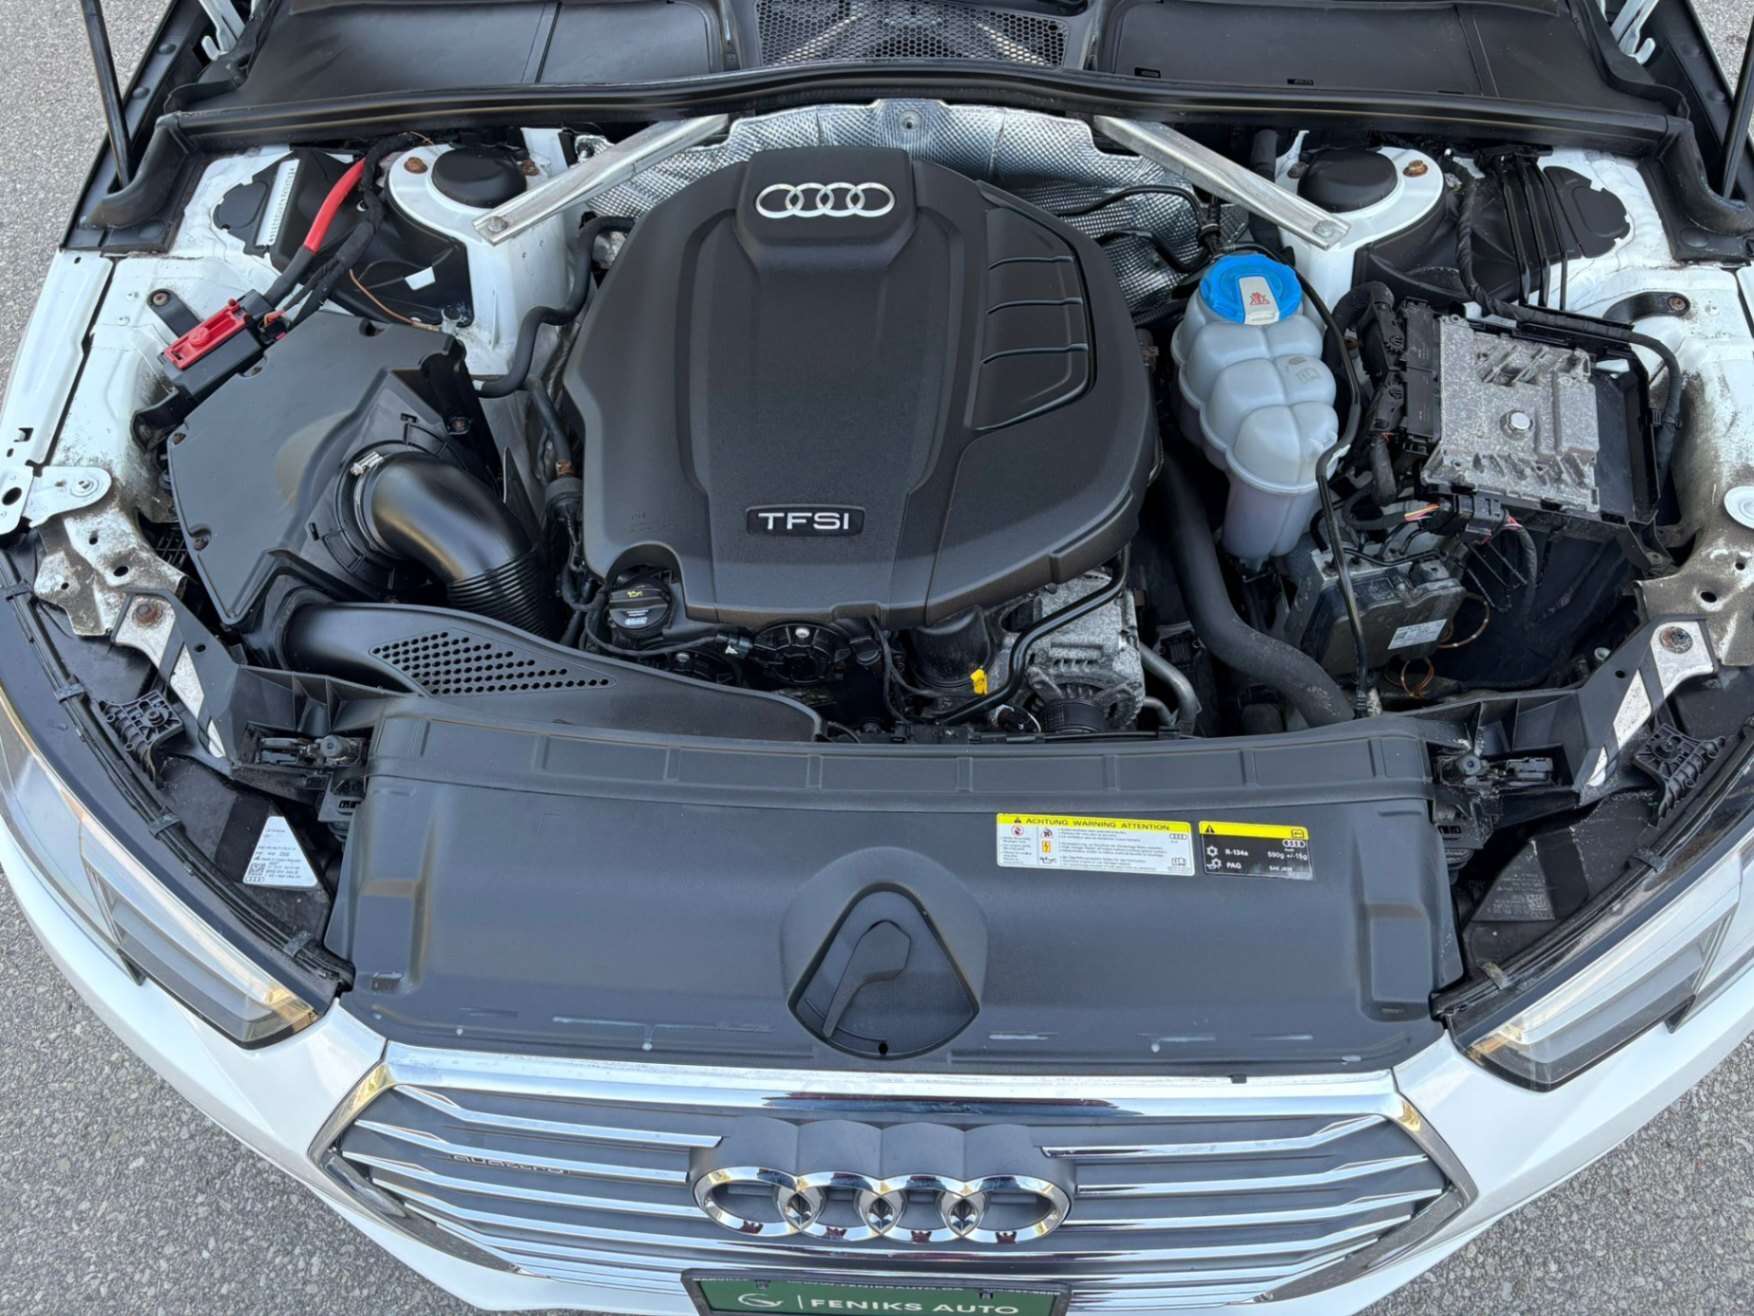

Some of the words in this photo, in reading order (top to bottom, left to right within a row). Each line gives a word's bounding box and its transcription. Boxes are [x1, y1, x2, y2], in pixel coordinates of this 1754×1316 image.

[758, 512, 849, 530] TFSI
[1026, 818, 1069, 826] ACHTUNG
[1073, 820, 1117, 829] WARNING
[1121, 822, 1171, 831] ATTENTION
[1225, 849, 1248, 857] R-134a
[811, 1298, 923, 1311] FENIKS
[933, 1303, 1020, 1315] AUTO
